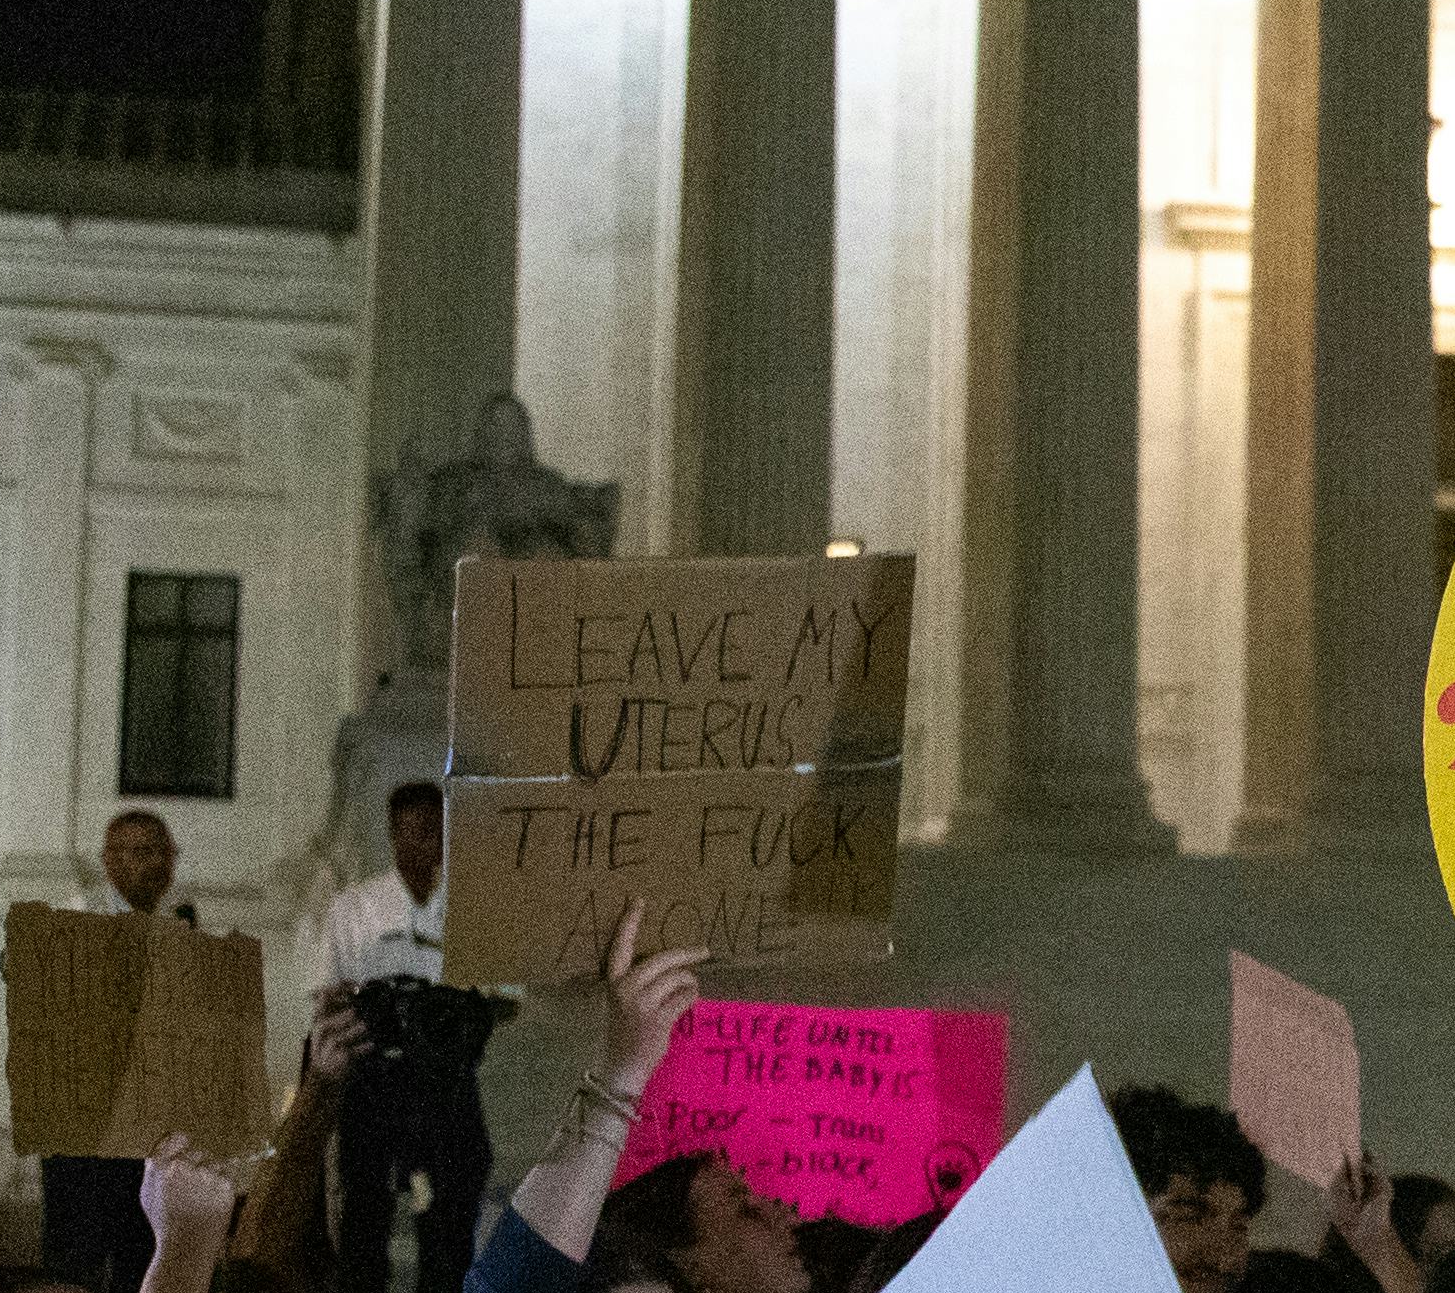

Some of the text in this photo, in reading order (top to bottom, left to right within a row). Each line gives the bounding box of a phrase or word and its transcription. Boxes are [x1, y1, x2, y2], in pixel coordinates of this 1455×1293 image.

[510, 575, 892, 690] LEAVE MY
[571, 695, 804, 783] UTERUS
[499, 800, 865, 872] THE FUCK
[555, 889, 797, 963] AONE
[707, 1046, 924, 1099] THE BABY IS
[807, 1020, 895, 1055] UNTIL
